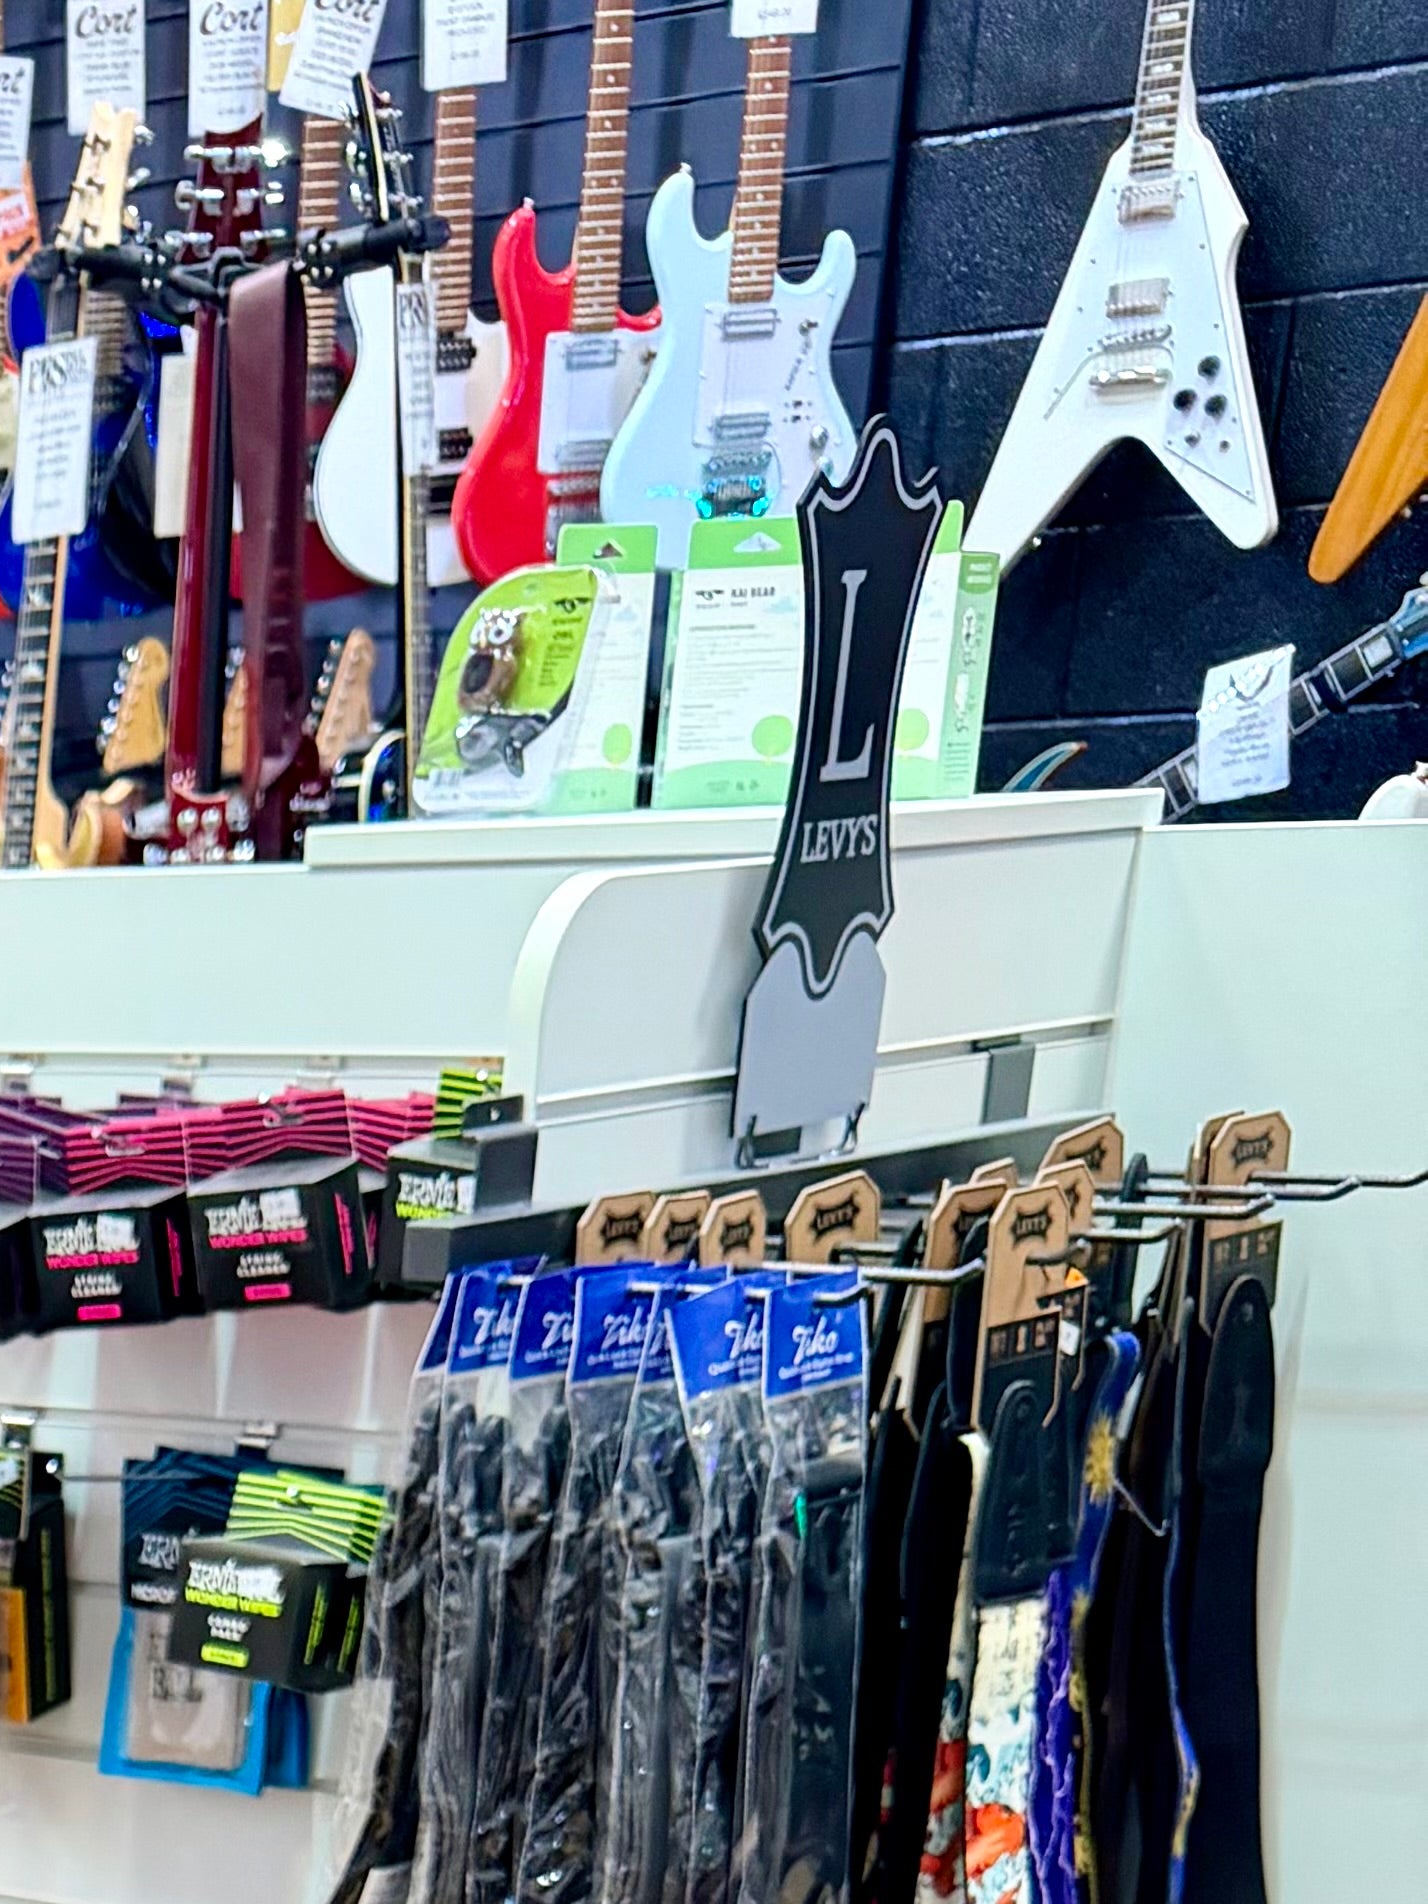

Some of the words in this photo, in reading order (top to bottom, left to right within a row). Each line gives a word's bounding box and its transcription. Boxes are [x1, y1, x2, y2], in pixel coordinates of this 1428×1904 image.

[76, 4, 138, 39] Cort
[199, 1, 264, 36] Cort
[818, 569, 875, 784] L
[398, 1172, 457, 1204] ERNIE
[208, 1232, 265, 1249] WONDER
[265, 1228, 307, 1245] WIPES
[46, 1253, 98, 1271] WONDER
[99, 1249, 138, 1267] WIPES
[138, 1533, 180, 1570] ERN
[186, 1585, 238, 1611] WONDER
